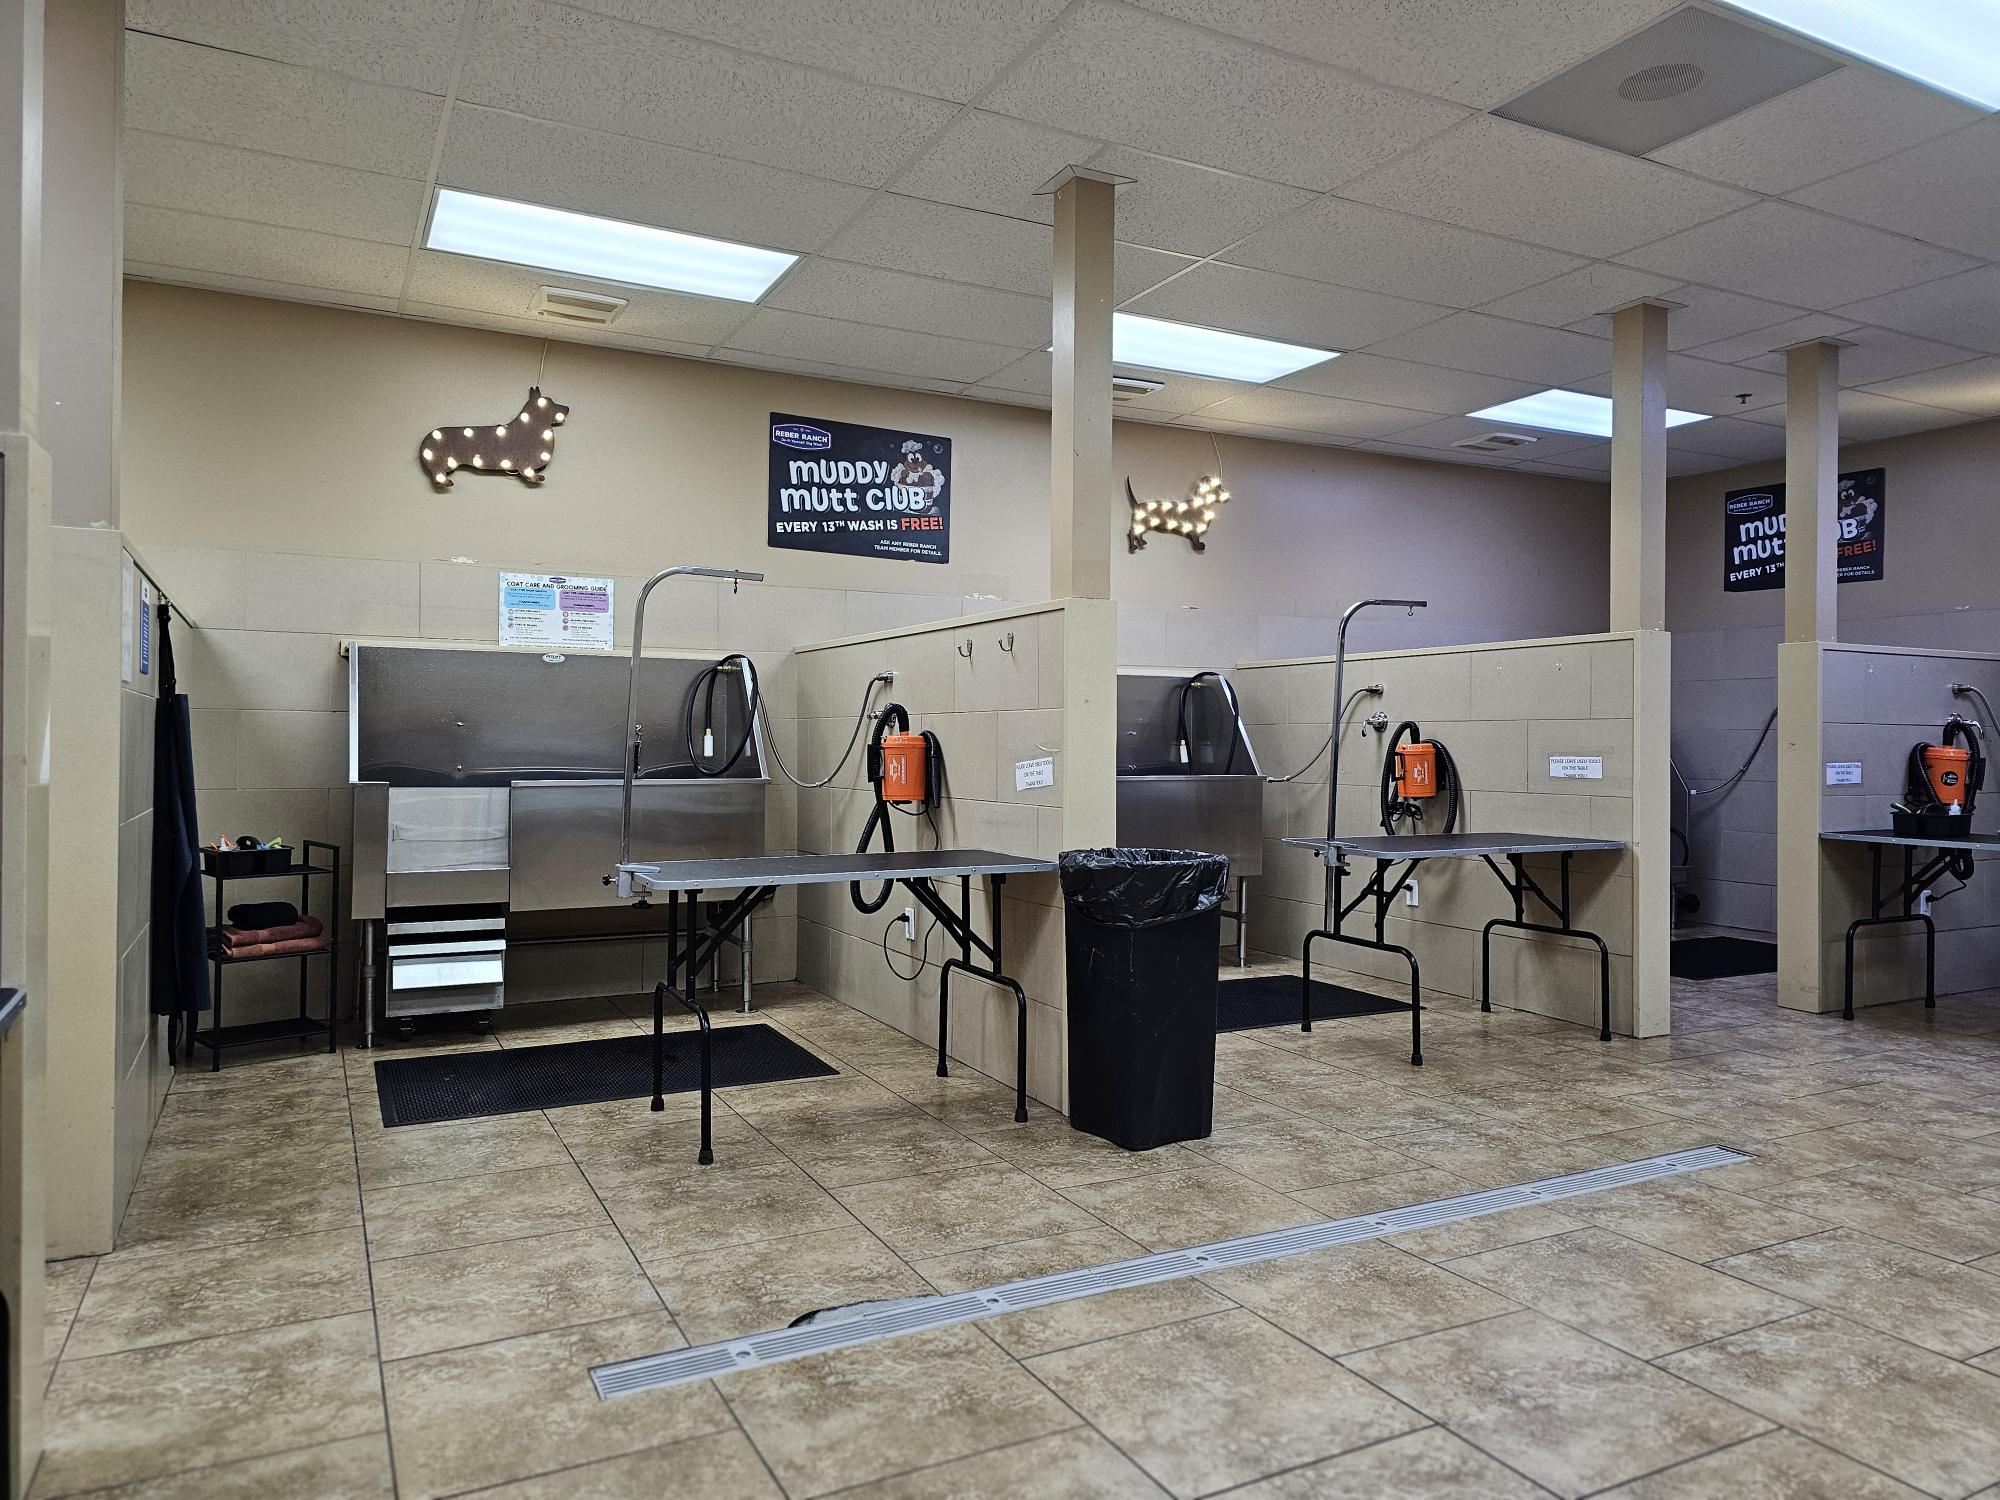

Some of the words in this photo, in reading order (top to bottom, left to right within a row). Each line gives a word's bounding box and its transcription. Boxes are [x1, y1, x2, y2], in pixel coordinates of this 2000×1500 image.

[775, 430, 800, 439] REBER
[801, 433, 828, 443] RANCH
[1748, 498, 1770, 507] RANCH
[775, 521, 817, 533] EVERY
[846, 519, 884, 532] WASH
[886, 519, 898, 531] IS
[900, 516, 944, 531] FREE!
[889, 545, 910, 553] MEMBER
[902, 541, 919, 549] REBER
[1729, 566, 1762, 582] EVERY
